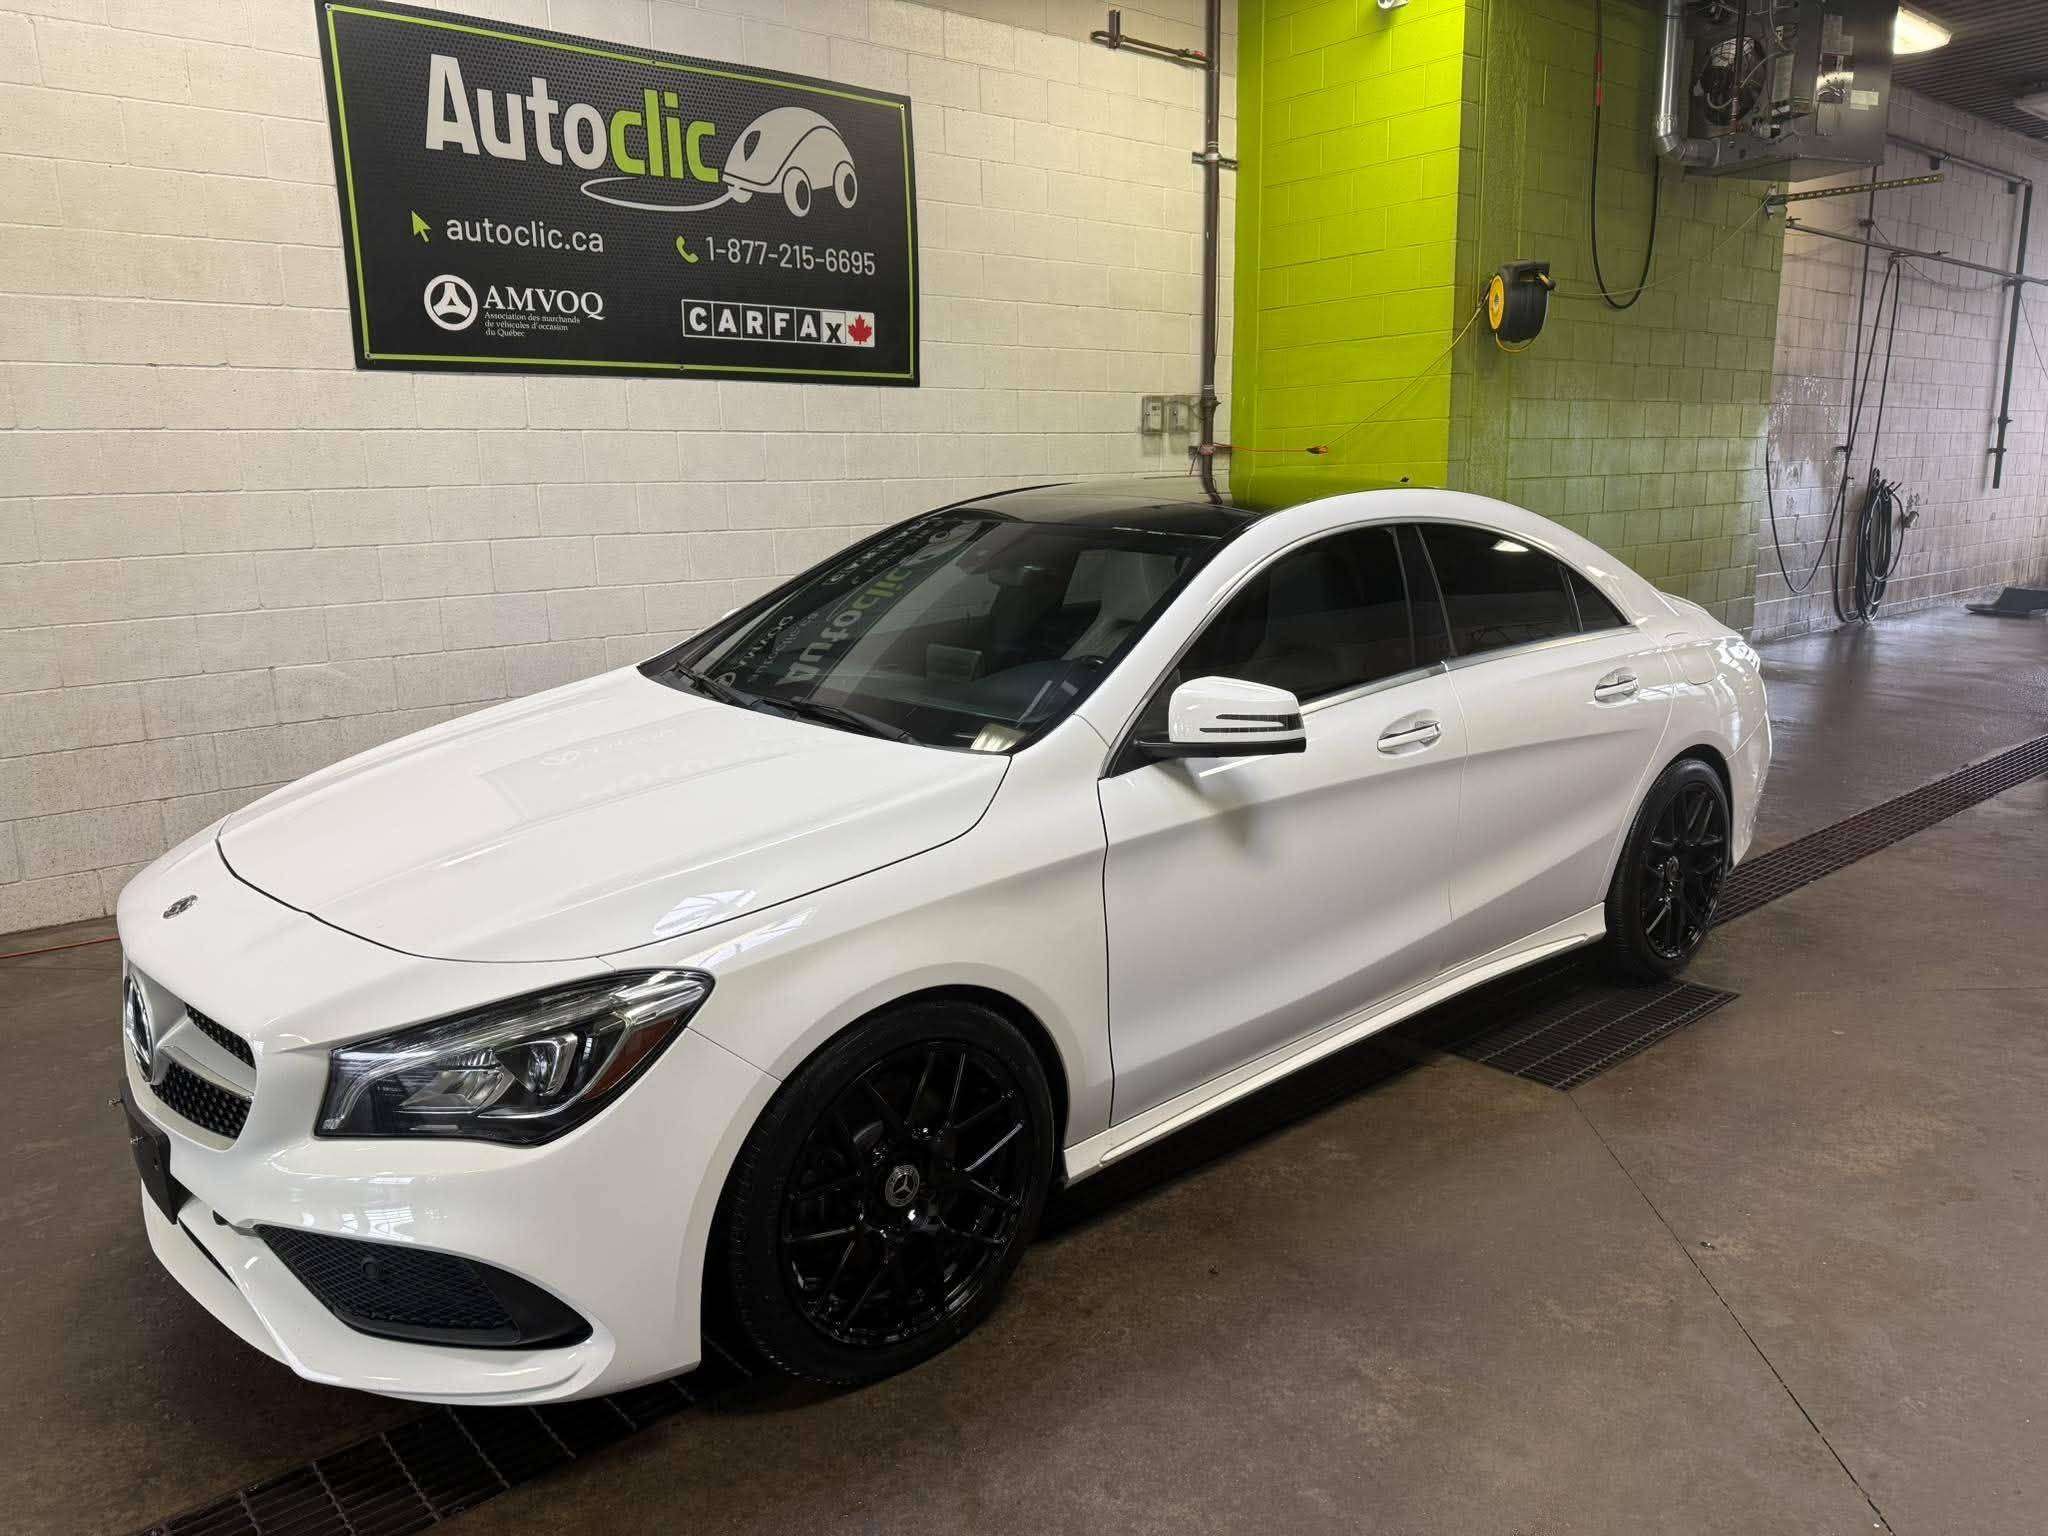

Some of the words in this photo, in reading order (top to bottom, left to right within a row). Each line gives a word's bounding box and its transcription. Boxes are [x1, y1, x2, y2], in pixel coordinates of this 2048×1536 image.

[425, 53, 720, 183] Autoclic
[446, 218, 604, 253] autoclic.ca
[705, 236, 876, 276] 1-877-215-6695
[482, 285, 606, 320] AMVOQ
[484, 311, 526, 321] Association
[528, 313, 541, 321] des
[541, 314, 581, 324] marchands
[485, 328, 496, 336] du
[496, 328, 526, 337] Québec
[495, 320, 530, 329] véhicules
[688, 306, 843, 344] CARFAX
